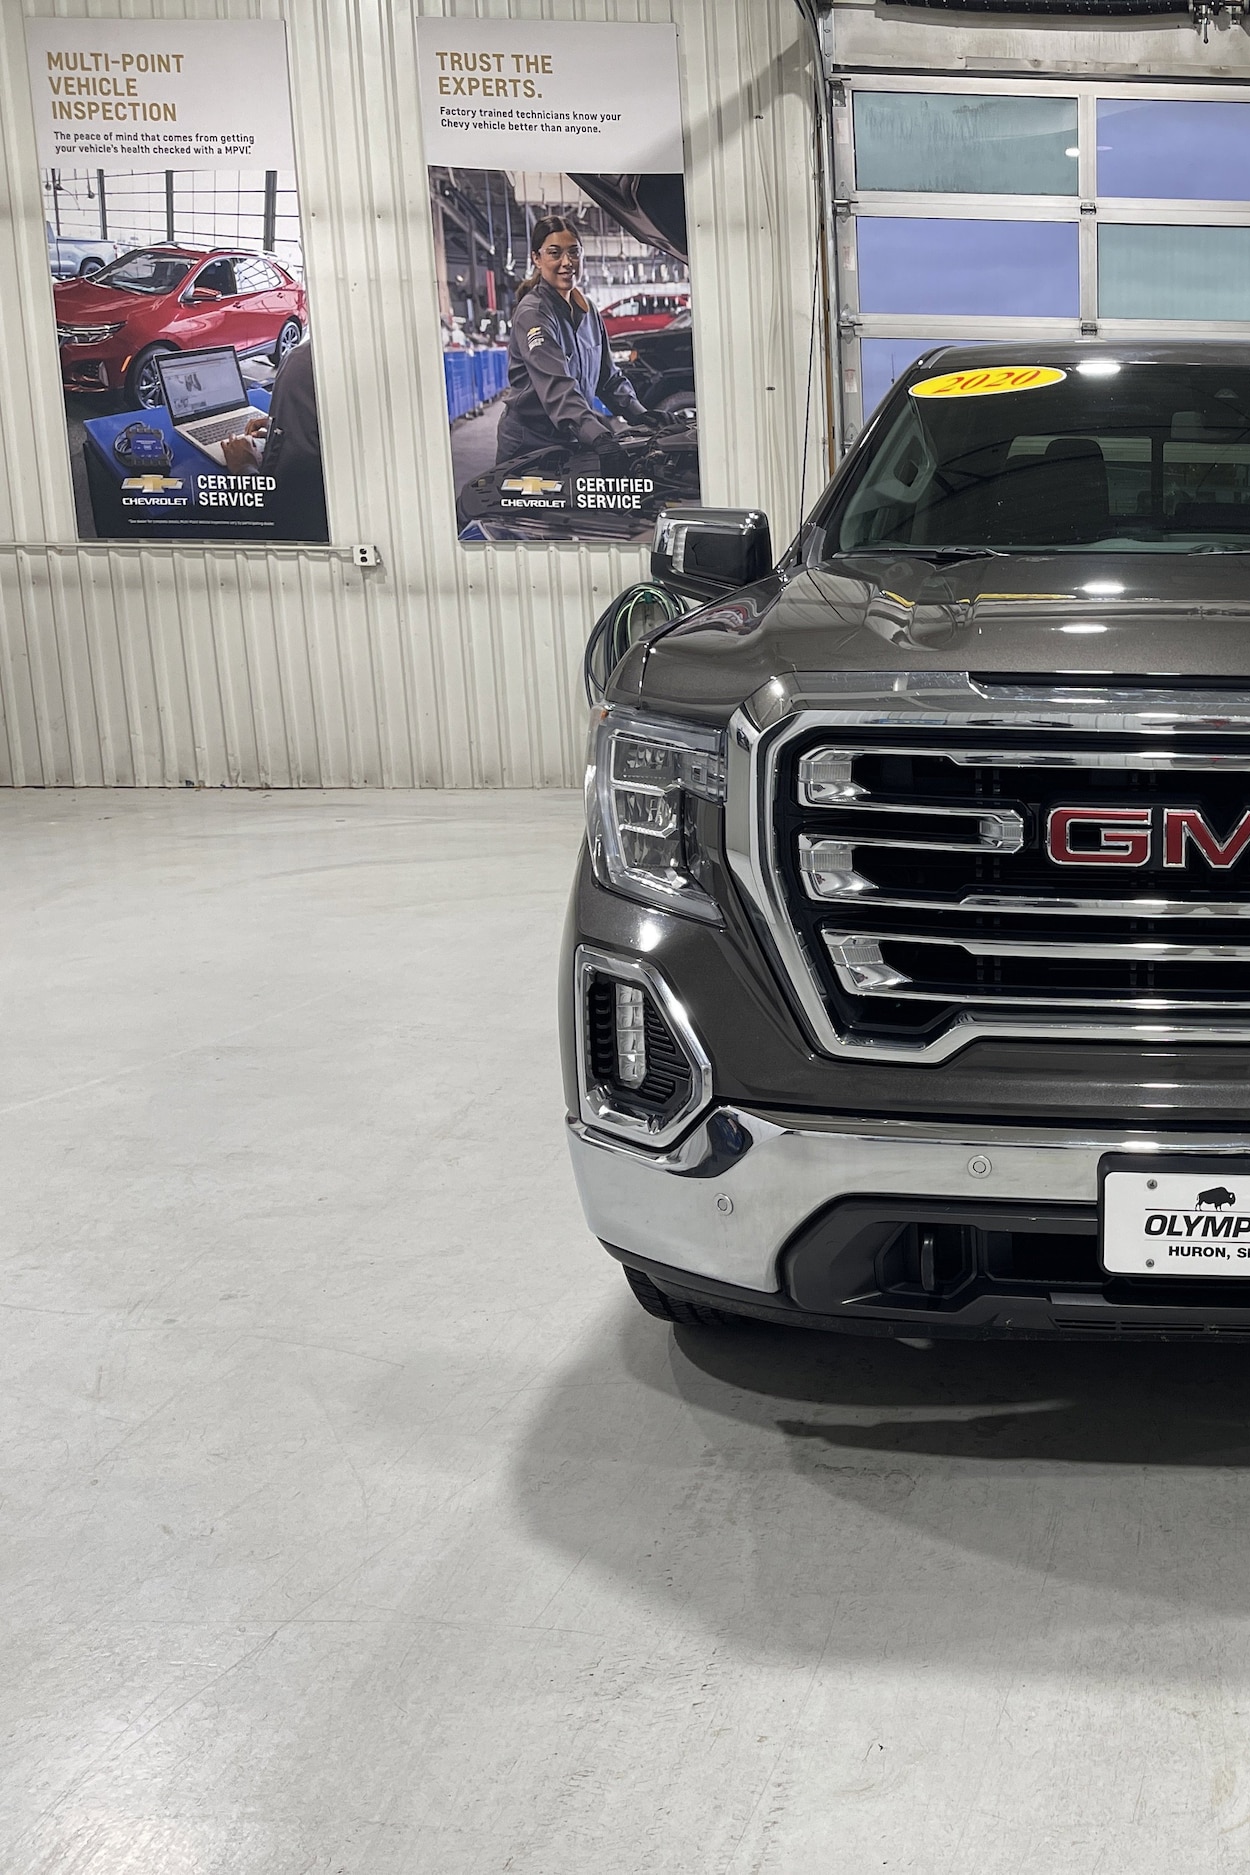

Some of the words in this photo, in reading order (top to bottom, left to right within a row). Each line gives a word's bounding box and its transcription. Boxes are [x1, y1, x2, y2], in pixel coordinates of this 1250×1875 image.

[47, 51, 184, 73] MULTI-POINT
[435, 51, 505, 73] TRUST
[511, 53, 553, 74] THE
[48, 76, 138, 97] VEHICLE
[438, 76, 542, 98] EXPERTS.
[51, 101, 177, 122] INSPECTION
[440, 106, 477, 118] Factory
[479, 108, 513, 118] trained
[516, 110, 570, 120] technicians
[572, 111, 598, 121] know
[600, 113, 622, 123] your
[441, 118, 470, 130] Chevy
[472, 120, 506, 130] vehicle
[508, 121, 538, 131] better
[540, 123, 562, 132] than
[564, 125, 601, 134] anyone.
[53, 131, 71, 140] The
[73, 132, 101, 142] peace
[103, 132, 113, 141] of
[115, 132, 138, 141] mind
[140, 132, 160, 142] that
[162, 134, 193, 142] comes
[195, 133, 218, 142] from
[220, 133, 255, 144] getting
[55, 145, 76, 154] your
[78, 144, 119, 153] vehicle's
[120, 144, 150, 154] health
[152, 145, 191, 154] checked
[193, 145, 214, 154] with
[932, 369, 1041, 394] 2020
[197, 474, 277, 491] CERTIFIED
[576, 477, 654, 493] CERTIFIED
[122, 497, 188, 506] CHEVROLET
[199, 491, 264, 507] SERVICE
[501, 499, 566, 508] CHEVROLET
[577, 494, 641, 509] SERVICE
[1168, 1246, 1230, 1260] HURON,
